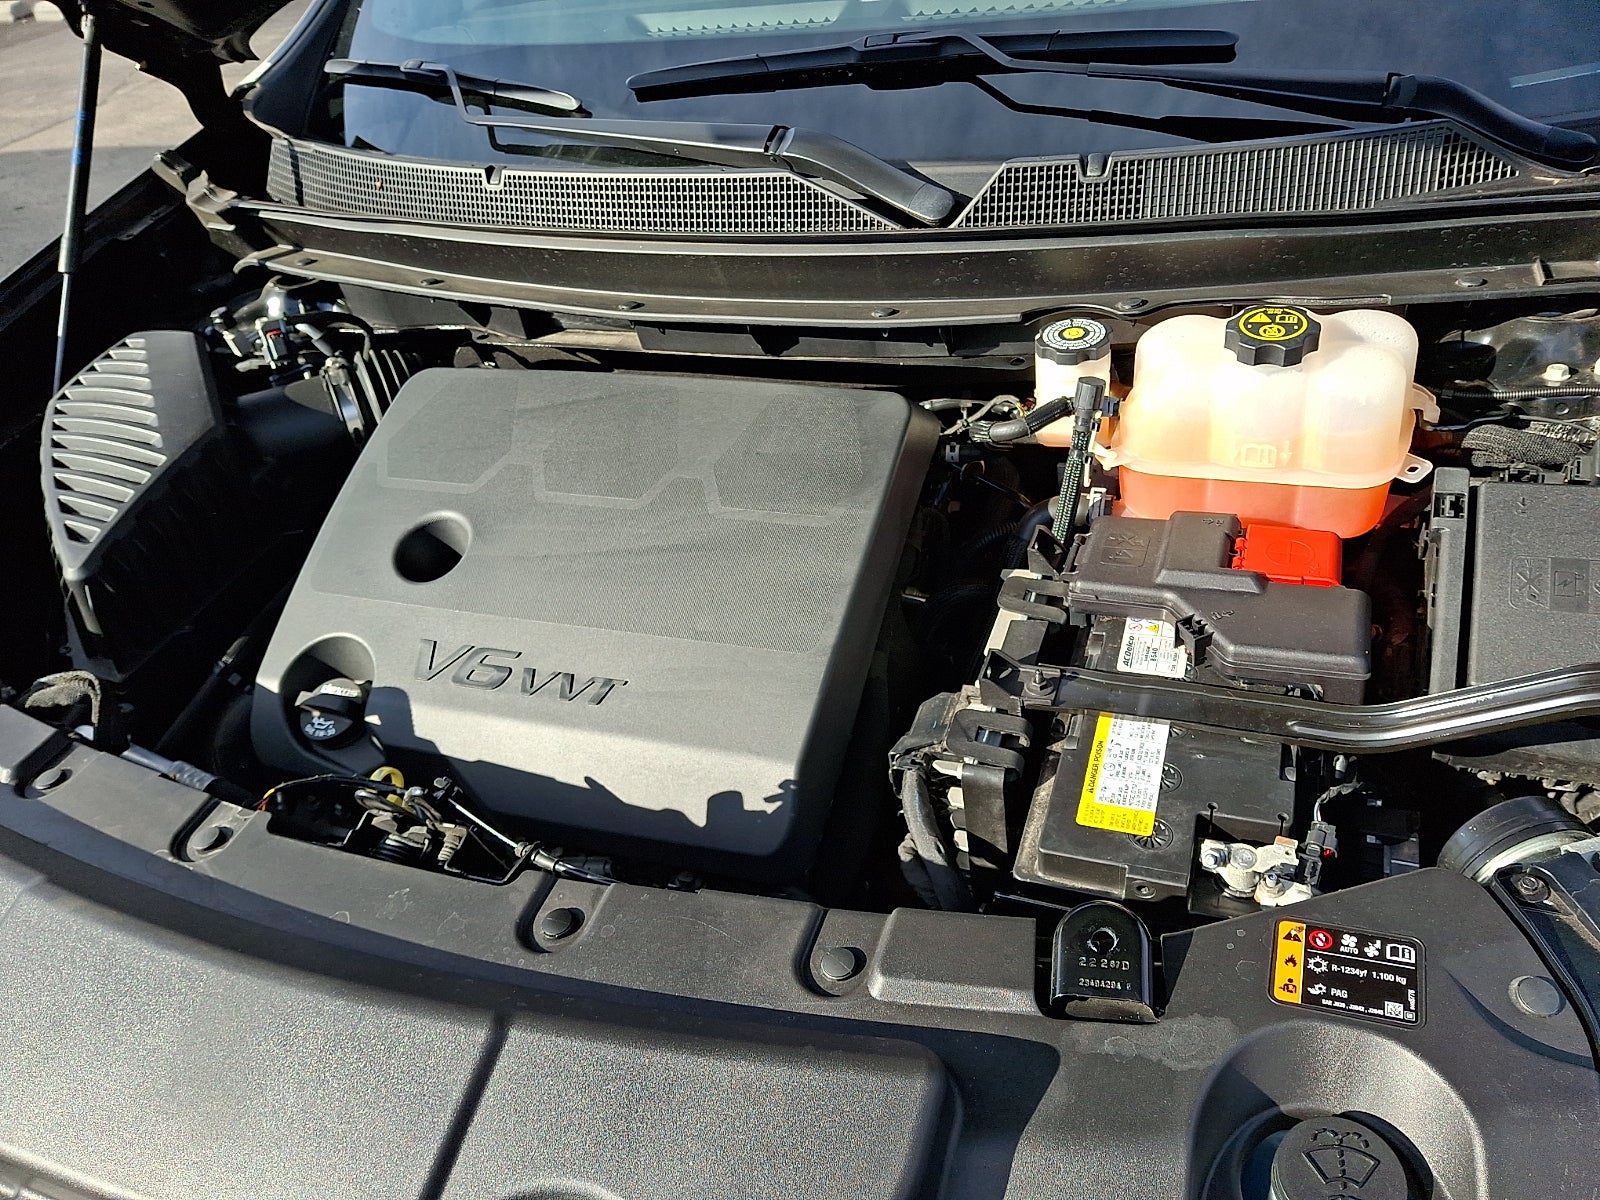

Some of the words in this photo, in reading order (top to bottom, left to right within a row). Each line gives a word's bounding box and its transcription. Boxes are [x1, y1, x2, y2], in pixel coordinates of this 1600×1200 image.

[1122, 636, 1135, 667] ACDelco
[414, 638, 523, 690] V6
[520, 667, 629, 706] VVT
[1088, 761, 1100, 791] DANGER
[1094, 740, 1104, 762] POISON
[1339, 946, 1359, 955] AUTO
[1331, 964, 1368, 978] R-1234yf
[1371, 971, 1395, 982] 1.100
[1395, 975, 1407, 985] kg
[1330, 988, 1348, 999] PAG
